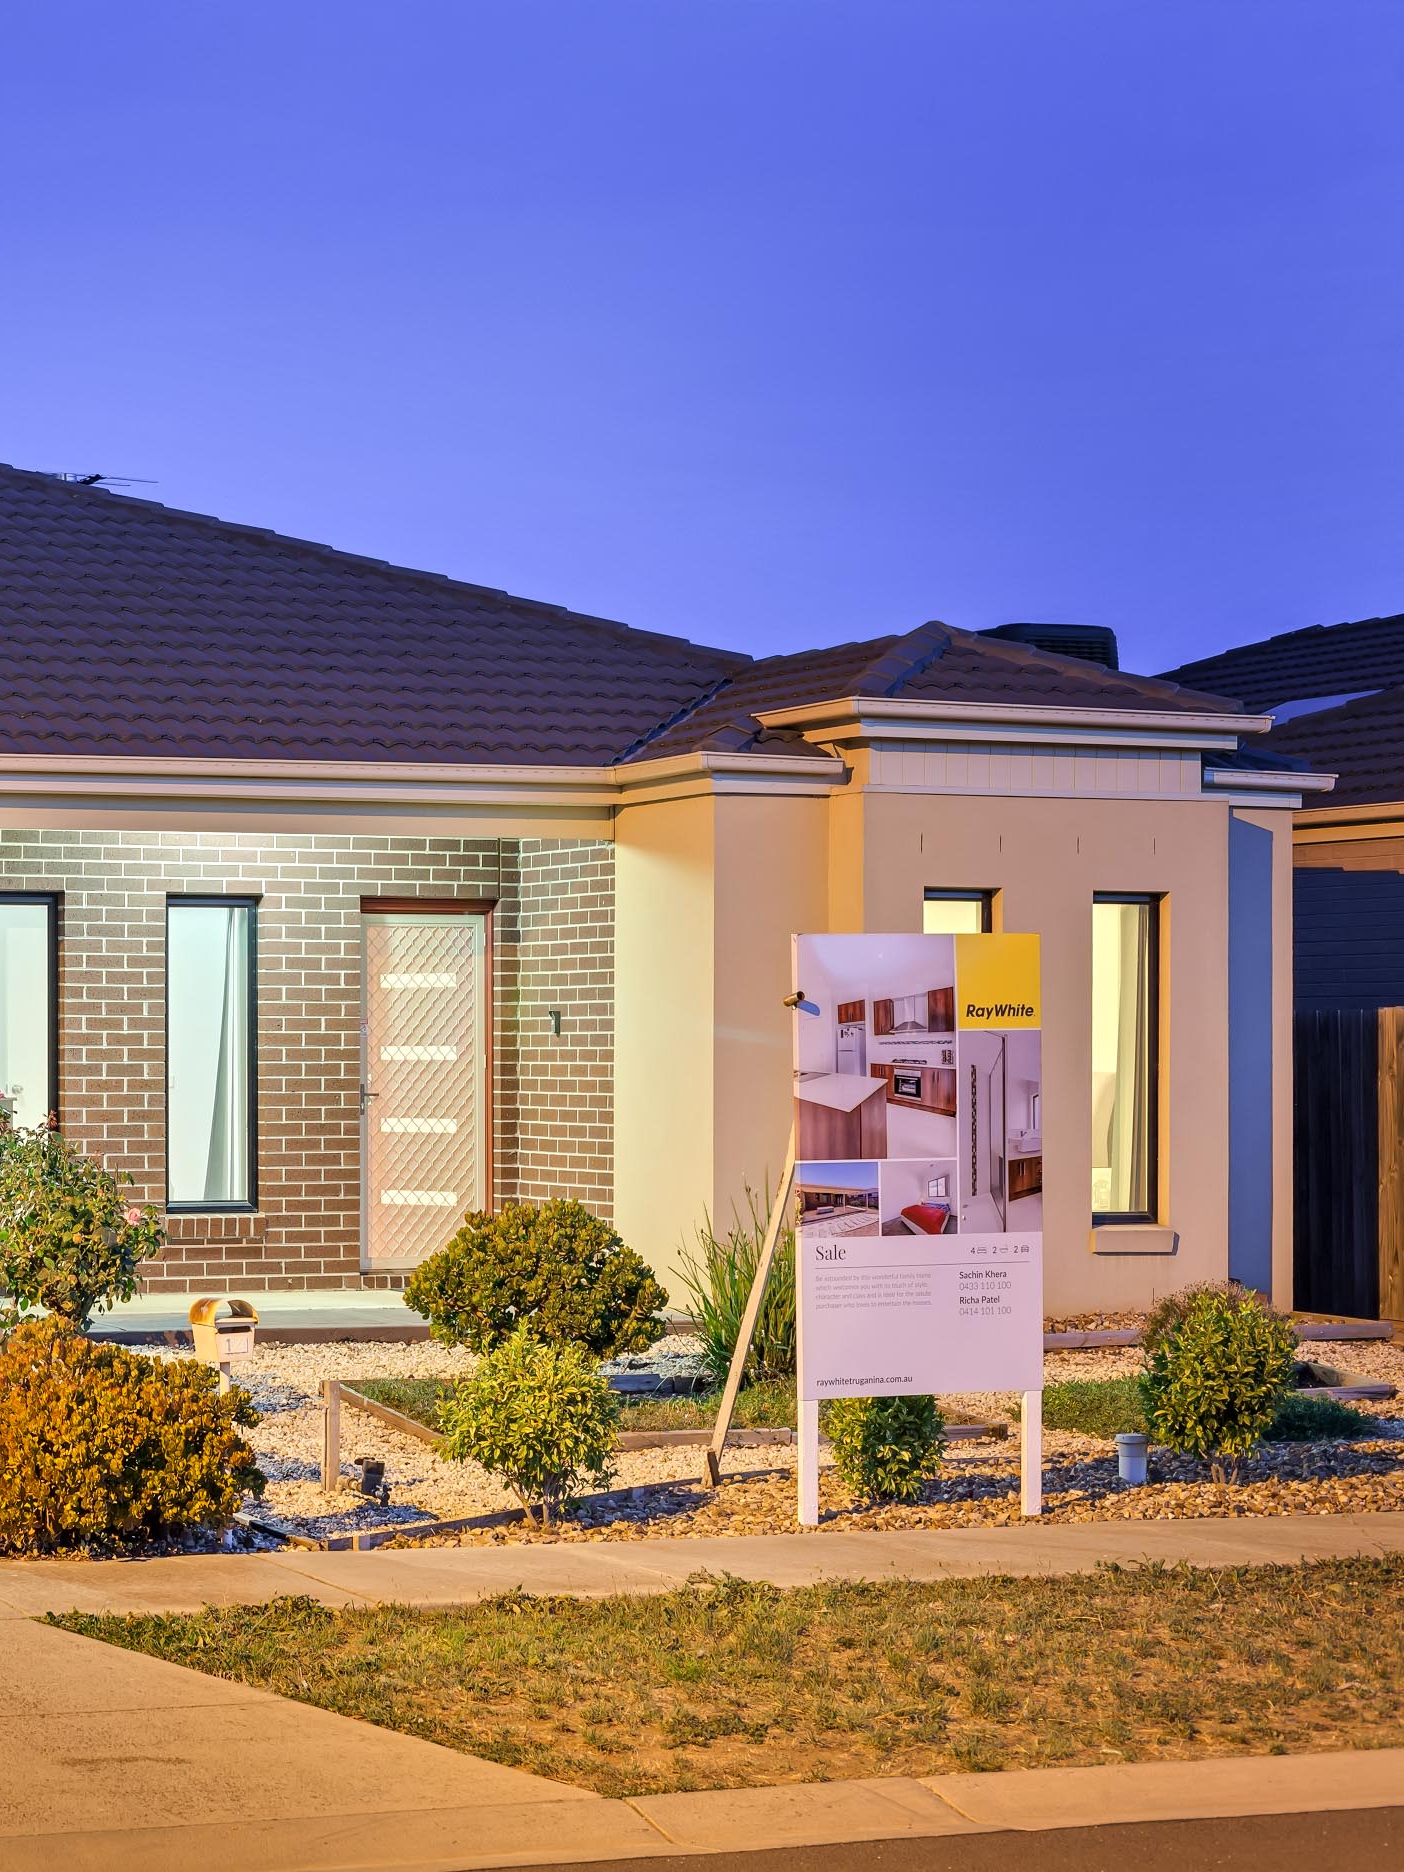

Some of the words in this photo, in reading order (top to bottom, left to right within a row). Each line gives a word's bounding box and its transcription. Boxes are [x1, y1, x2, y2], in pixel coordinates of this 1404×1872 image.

[966, 1004, 1034, 1020] RayWhite
[816, 1245, 846, 1260] Sale
[993, 1246, 997, 1254] 2
[959, 1271, 983, 1279] Sachin
[985, 1270, 1007, 1278] Khera
[959, 1282, 979, 1291] 0433
[981, 1281, 995, 1290] 110
[998, 1281, 1012, 1289] 100
[959, 1296, 979, 1304] Richa
[982, 1296, 1001, 1304] Patel
[959, 1308, 979, 1316] 0414
[981, 1306, 995, 1315] 101
[998, 1306, 1012, 1314] 100
[816, 1376, 913, 1387] raywhitetruganina.com.au
